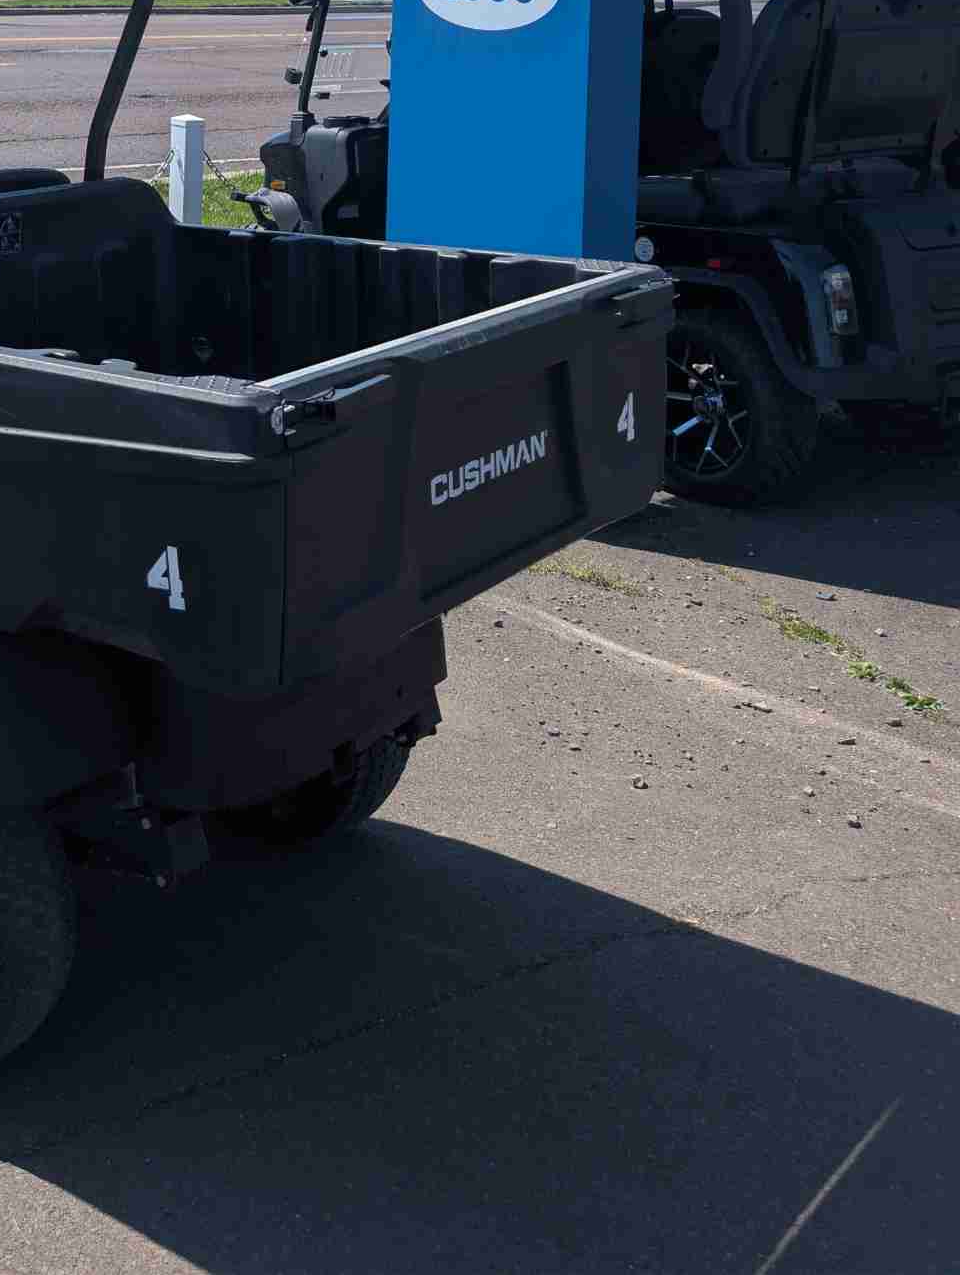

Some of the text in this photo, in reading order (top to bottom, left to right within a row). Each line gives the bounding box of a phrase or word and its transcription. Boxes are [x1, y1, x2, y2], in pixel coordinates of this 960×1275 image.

[616, 391, 635, 442] 4
[430, 429, 547, 506] CUSHMAN
[146, 545, 186, 611] 4
